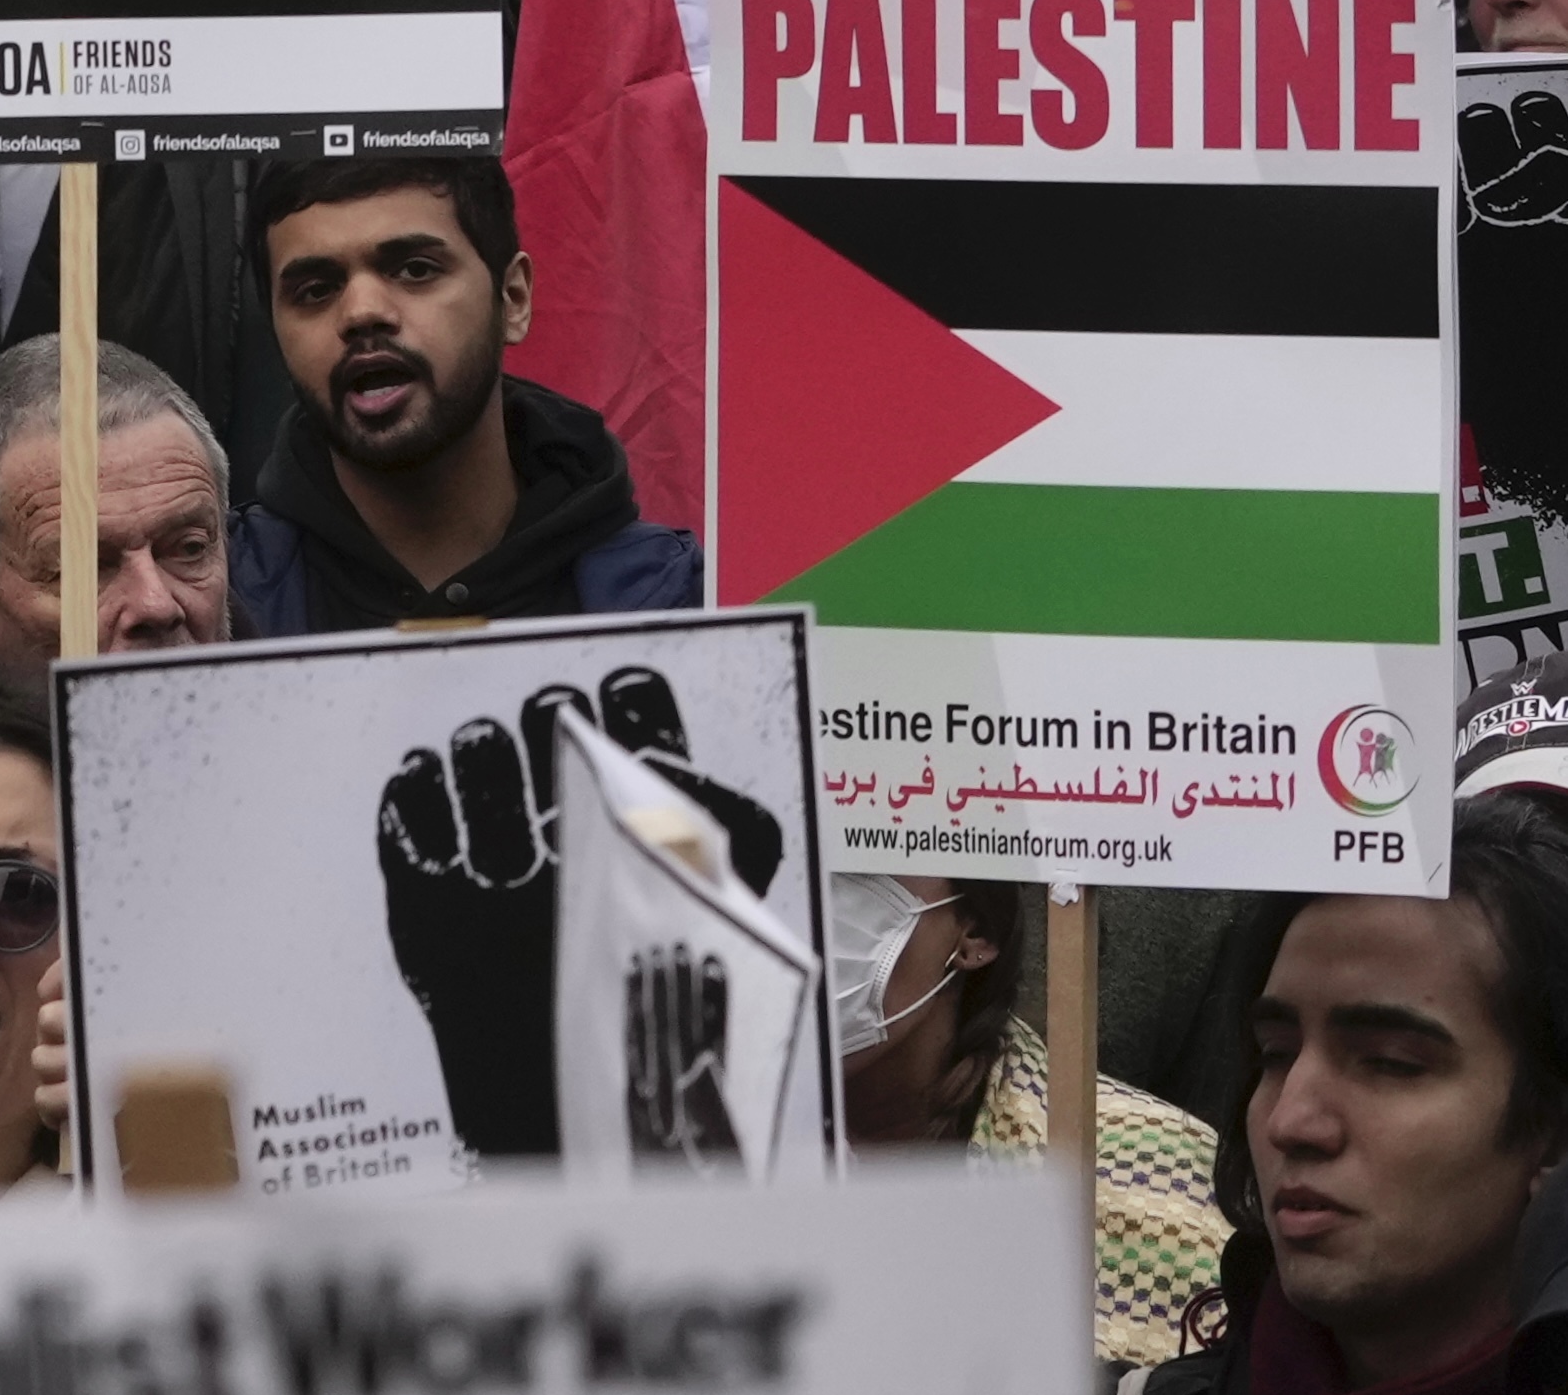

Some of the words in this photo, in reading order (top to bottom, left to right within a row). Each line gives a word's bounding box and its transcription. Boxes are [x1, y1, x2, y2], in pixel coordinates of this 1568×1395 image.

[72, 39, 172, 69] FRIENDS
[73, 74, 93, 96] OF
[100, 73, 172, 98] AL-AQSA
[152, 132, 280, 157] friendsofalaqsa
[363, 127, 490, 151] friendsofalaqsa
[946, 704, 1079, 749] Forum
[1094, 711, 1132, 752] in
[1147, 712, 1296, 756] Britain
[888, 755, 936, 825] في
[946, 765, 1159, 826] الفلسطيني
[1171, 771, 1296, 819] المنتدى
[844, 825, 1173, 866] www.palestinianforum.org.uk
[1332, 831, 1404, 864] PFB
[252, 1094, 365, 1131] Muslim
[256, 1115, 441, 1163] Association
[261, 1168, 295, 1196] of
[303, 1150, 413, 1188] Britain
